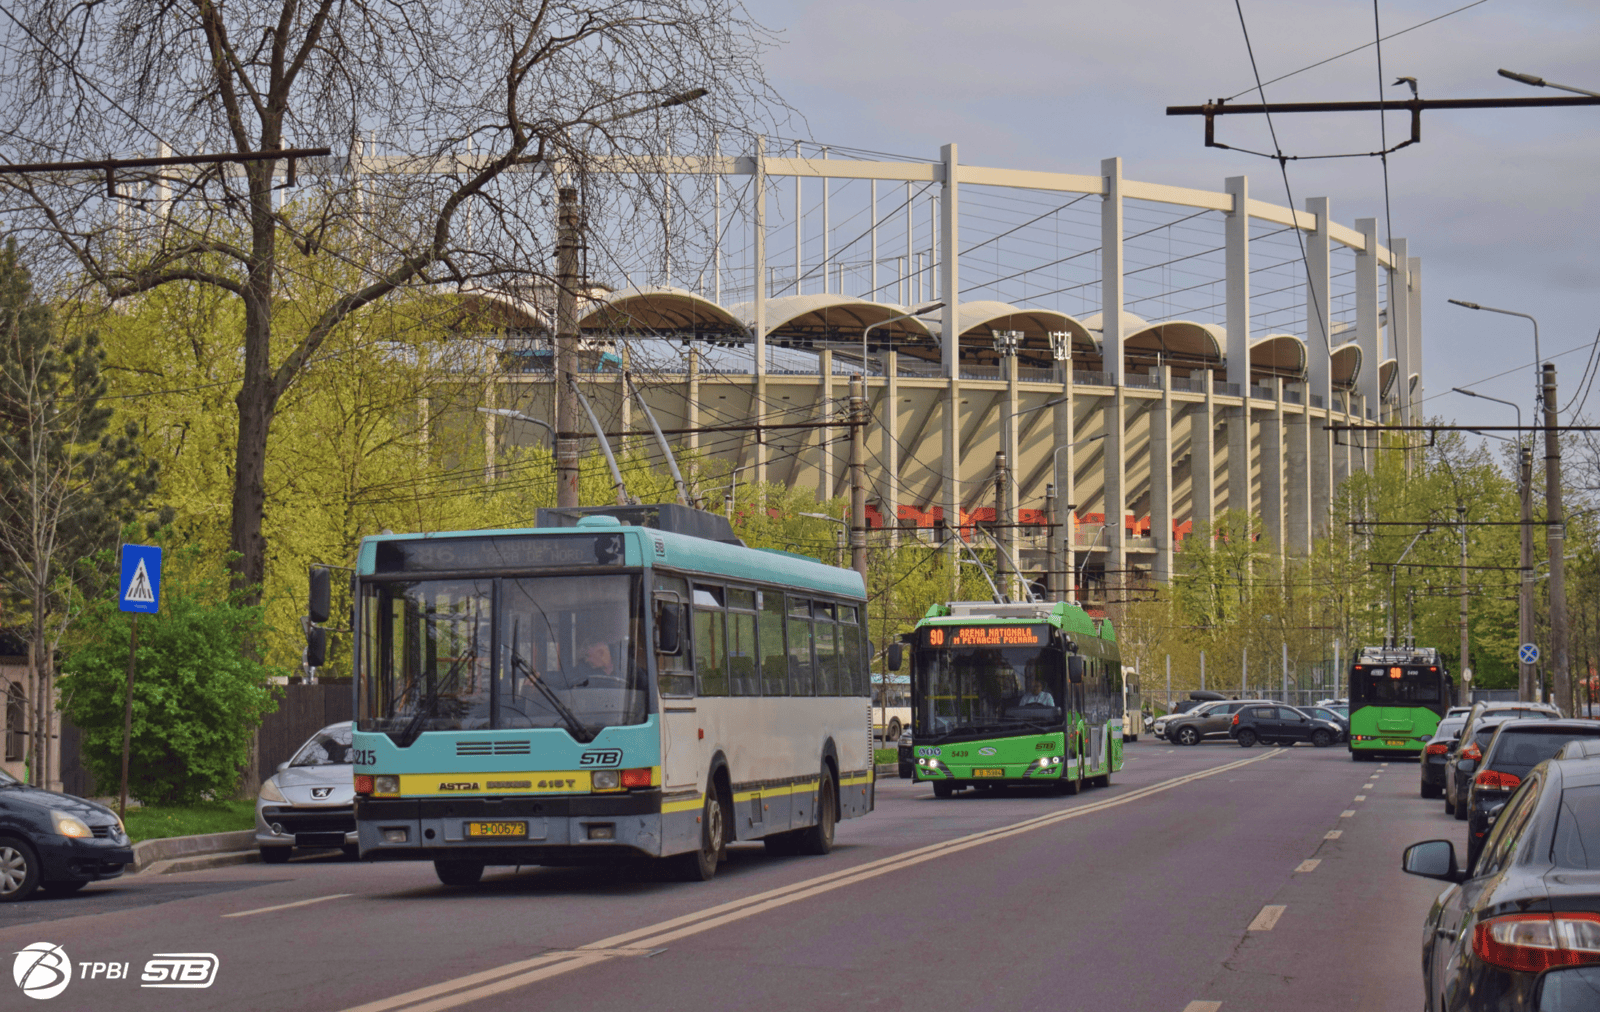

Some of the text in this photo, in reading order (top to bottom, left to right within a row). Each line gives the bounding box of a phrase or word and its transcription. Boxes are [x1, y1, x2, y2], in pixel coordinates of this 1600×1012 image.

[486, 550, 520, 563] GARA
[526, 549, 543, 561] DE
[551, 548, 584, 561] NORD
[930, 628, 944, 645] 90
[959, 627, 1032, 637] ARENA NATIONALA
[962, 636, 1001, 645] PETRACHE
[1003, 635, 1038, 644] POENARU
[1390, 667, 1402, 679] 90
[579, 750, 620, 766] STB
[951, 750, 969, 758] 5439
[439, 782, 480, 791] ASTRA
